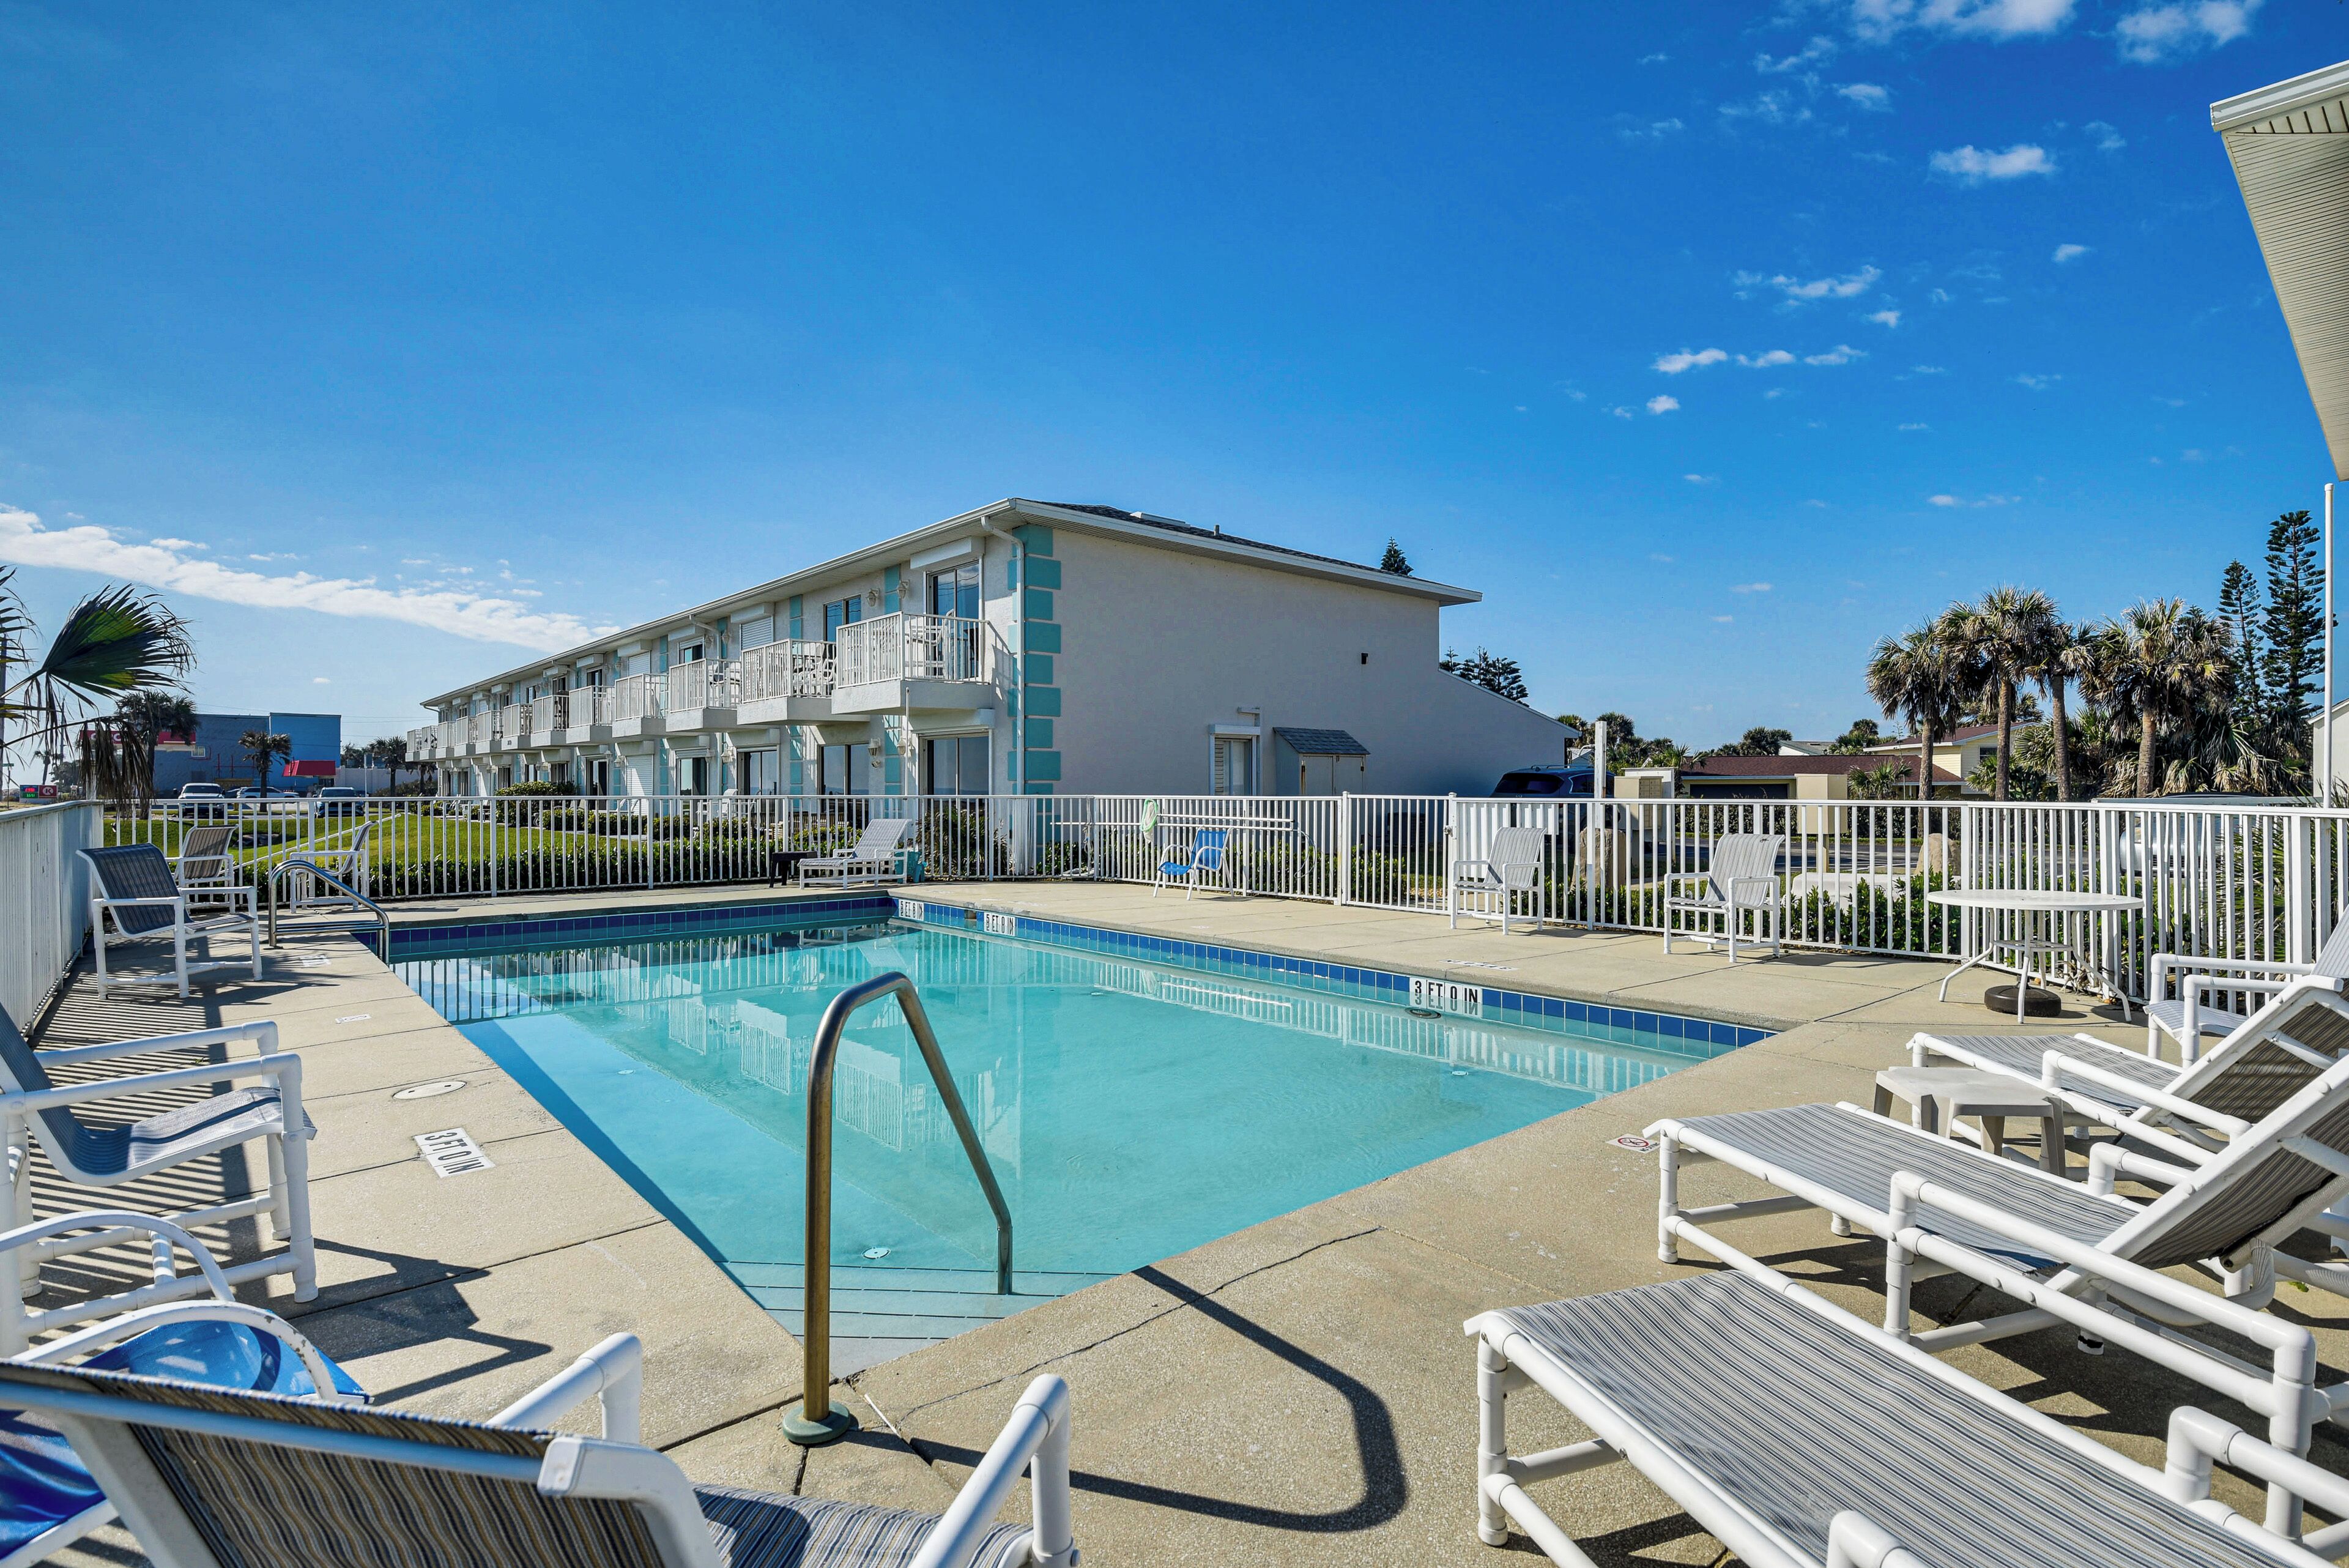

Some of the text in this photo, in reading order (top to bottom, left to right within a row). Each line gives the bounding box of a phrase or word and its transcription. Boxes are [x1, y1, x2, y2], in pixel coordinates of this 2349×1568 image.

[1415, 980, 1422, 994] 3
[1450, 986, 1457, 999] 0
[425, 1132, 484, 1174] 3 FT 0 IN
